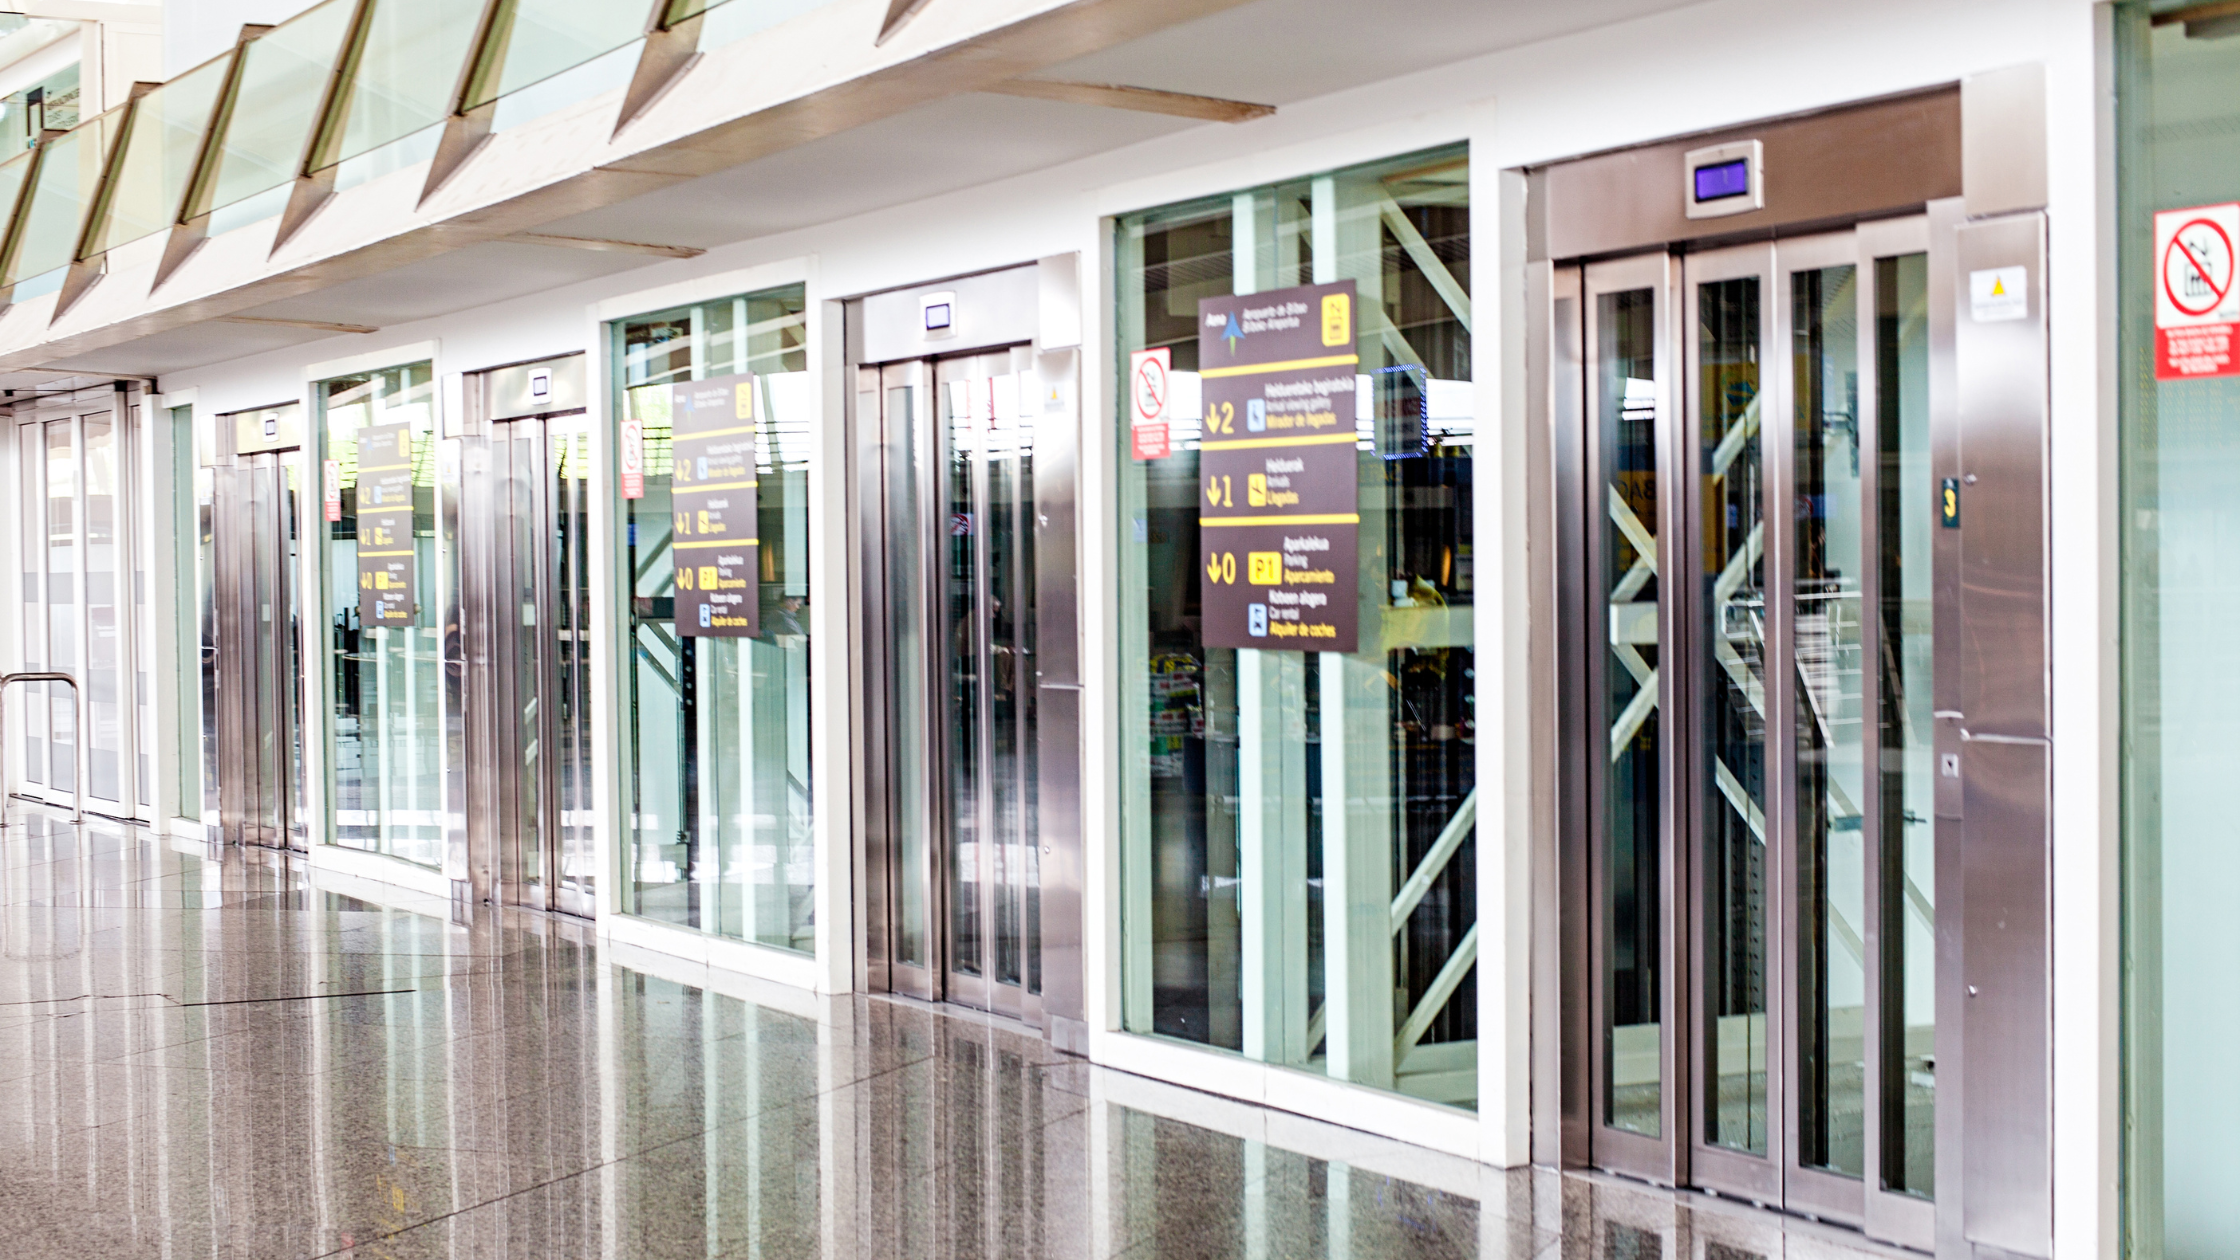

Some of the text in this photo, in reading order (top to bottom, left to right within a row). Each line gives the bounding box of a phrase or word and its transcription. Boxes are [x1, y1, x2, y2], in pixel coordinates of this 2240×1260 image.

[1221, 401, 1234, 434] 2
[683, 459, 691, 482] 2
[1222, 474, 1234, 508] 1
[1944, 488, 1956, 517] 3
[684, 512, 691, 534] 1
[685, 567, 693, 590] 0
[1222, 552, 1236, 585] 0
[1255, 557, 1274, 580] P1
[1298, 622, 1309, 637] de
